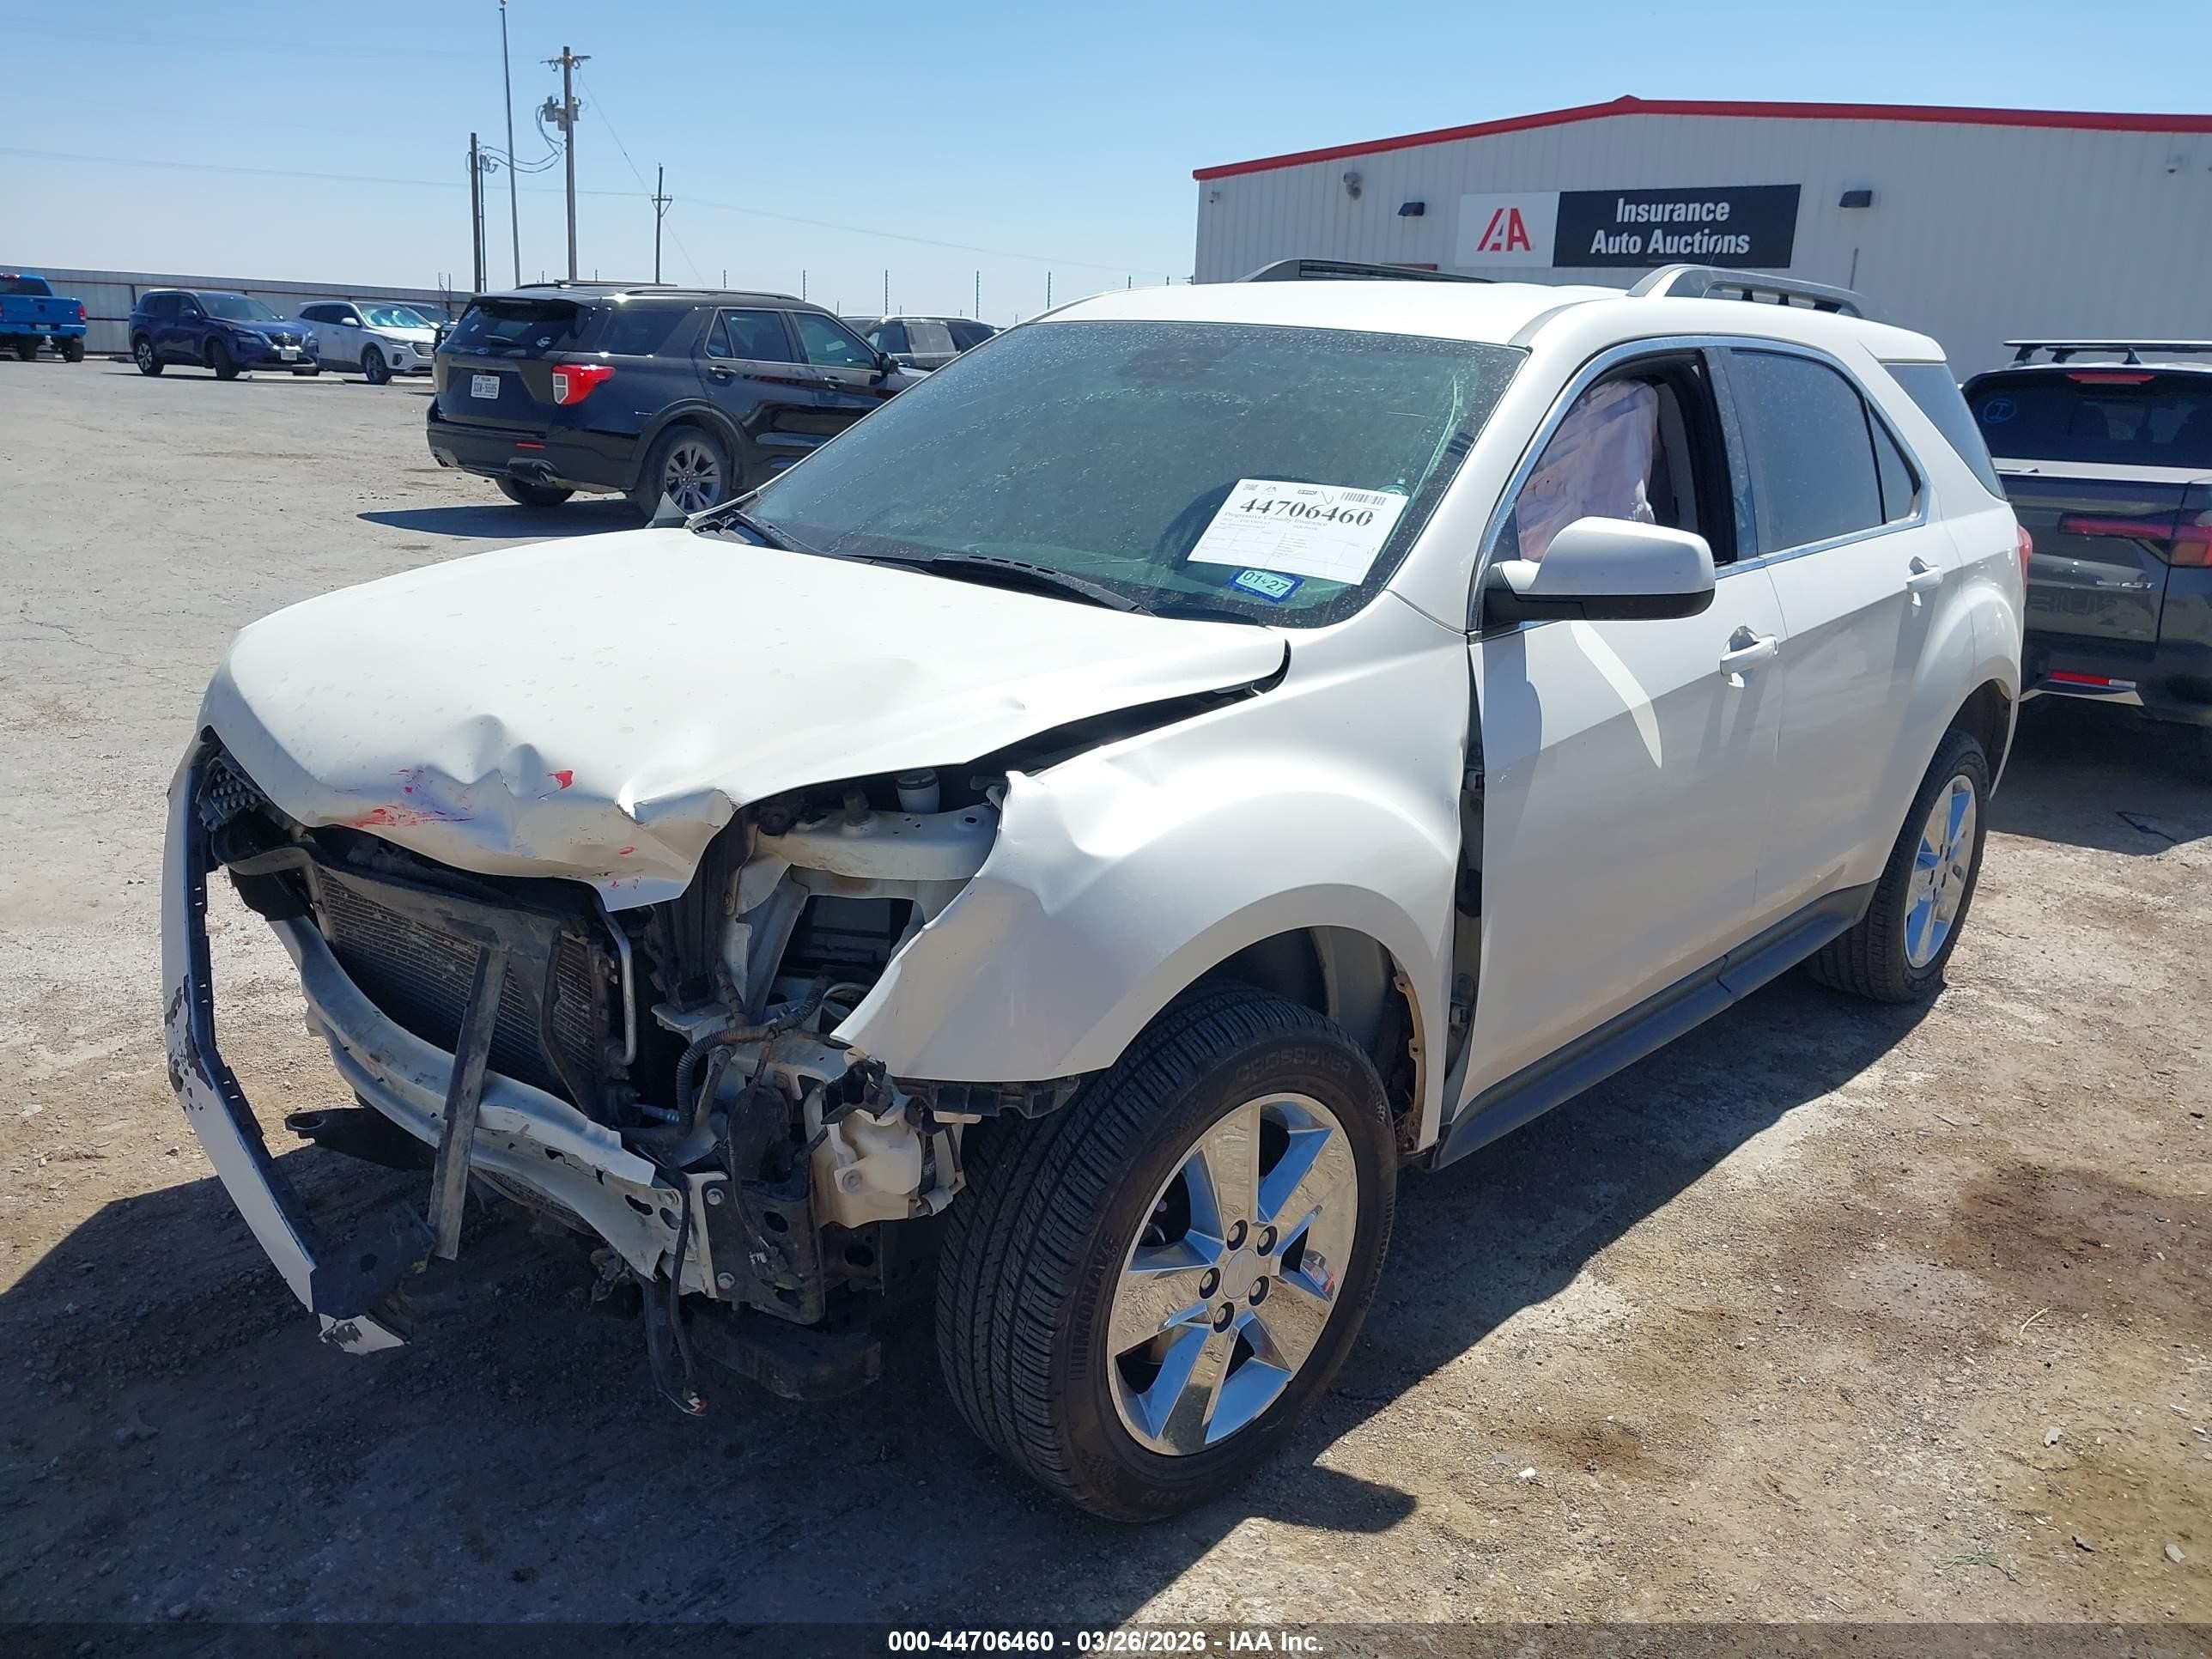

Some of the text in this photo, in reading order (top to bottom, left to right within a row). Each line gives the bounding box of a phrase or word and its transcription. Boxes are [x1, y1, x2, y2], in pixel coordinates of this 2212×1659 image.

[1616, 198, 1730, 223] Insurance
[1589, 228, 1751, 255] Auto Auctions
[1239, 497, 1374, 526] 44706460
